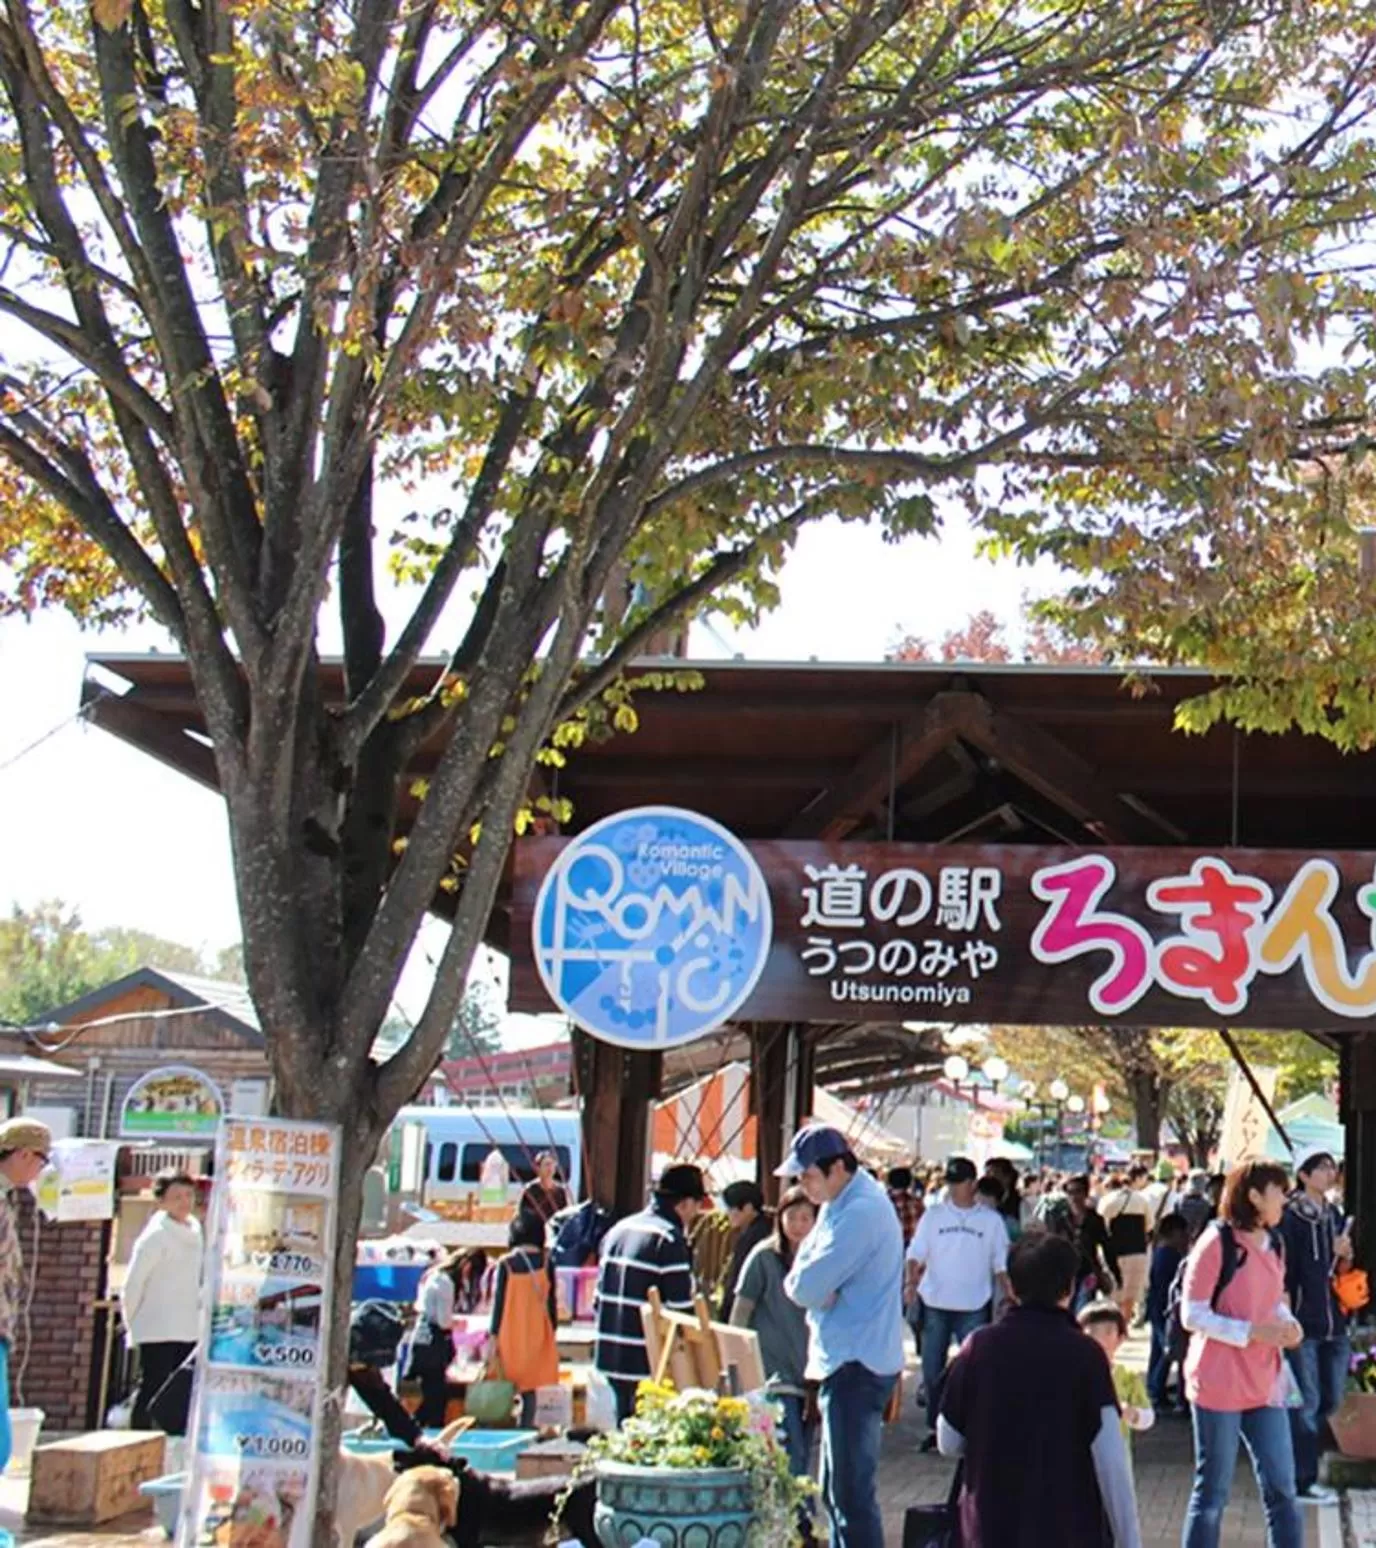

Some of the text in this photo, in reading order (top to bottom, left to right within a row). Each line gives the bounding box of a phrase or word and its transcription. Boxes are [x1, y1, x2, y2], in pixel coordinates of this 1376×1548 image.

[637, 842, 724, 860] Romantic
[659, 861, 723, 880] Village
[800, 863, 1001, 931] 道の駅
[801, 936, 999, 979] うつのみや
[830, 980, 971, 1007] Utsunomiya
